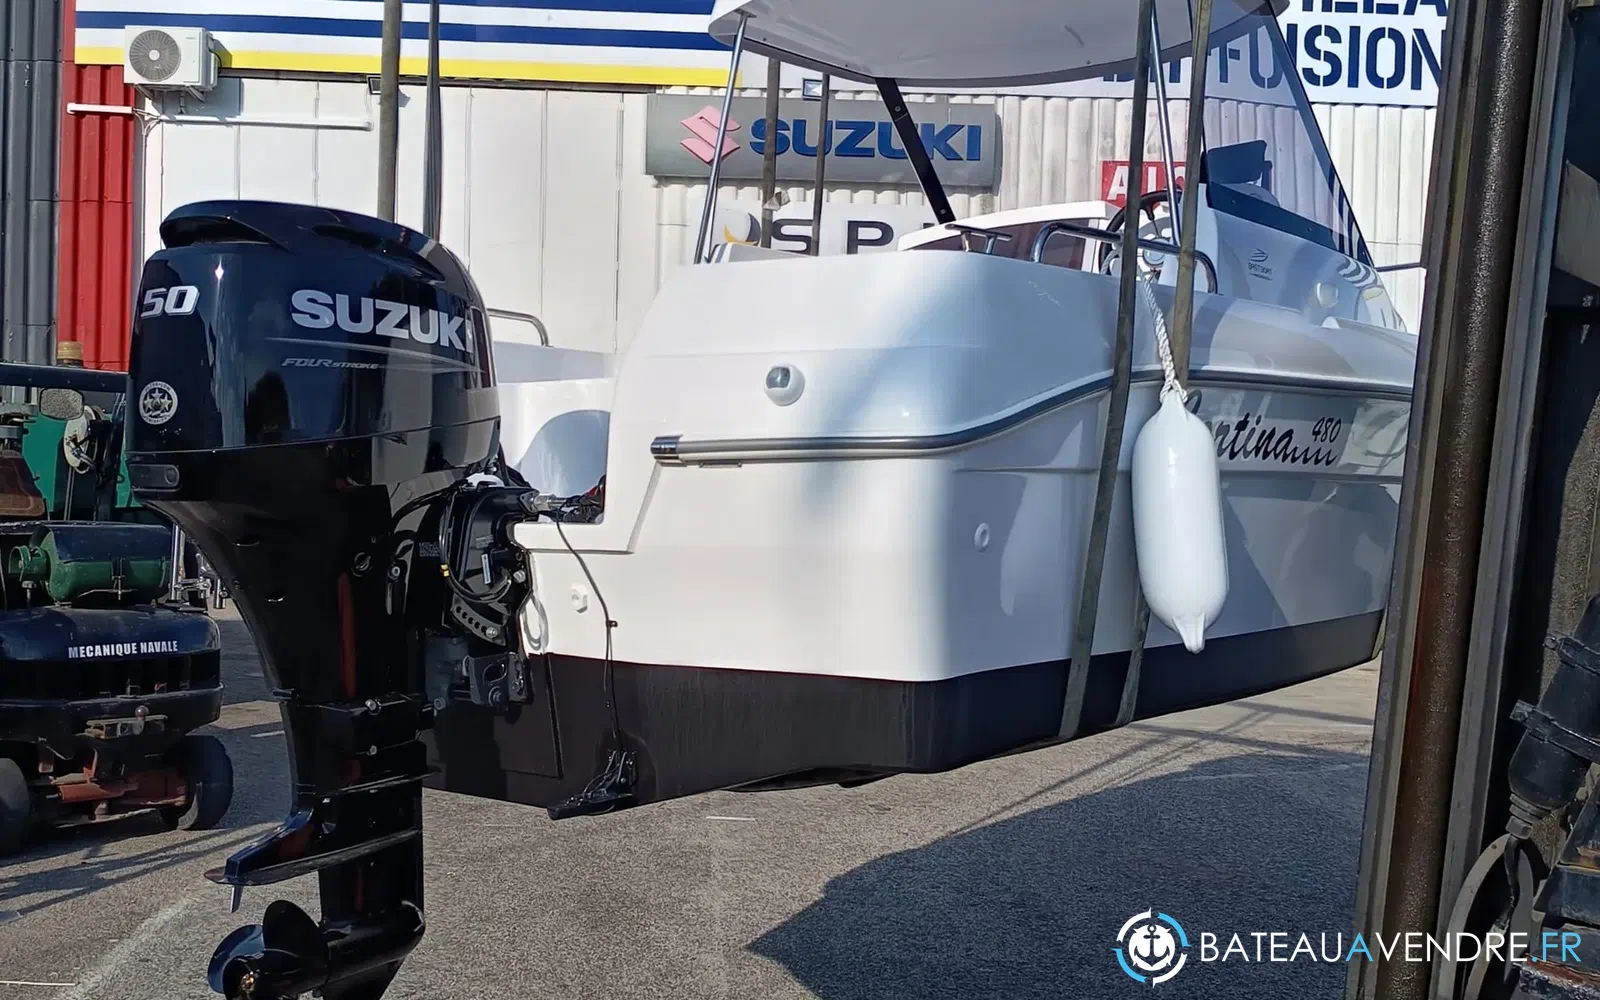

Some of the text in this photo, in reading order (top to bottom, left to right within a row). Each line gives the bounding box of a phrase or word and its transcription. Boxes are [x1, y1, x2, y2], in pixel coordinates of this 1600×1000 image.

[750, 117, 981, 162] SUZUKI
[140, 285, 200, 319] 50
[291, 288, 474, 354] SUZUKI
[1311, 416, 1342, 444] 480
[68, 640, 179, 659] MECANIQUE NAVALE
